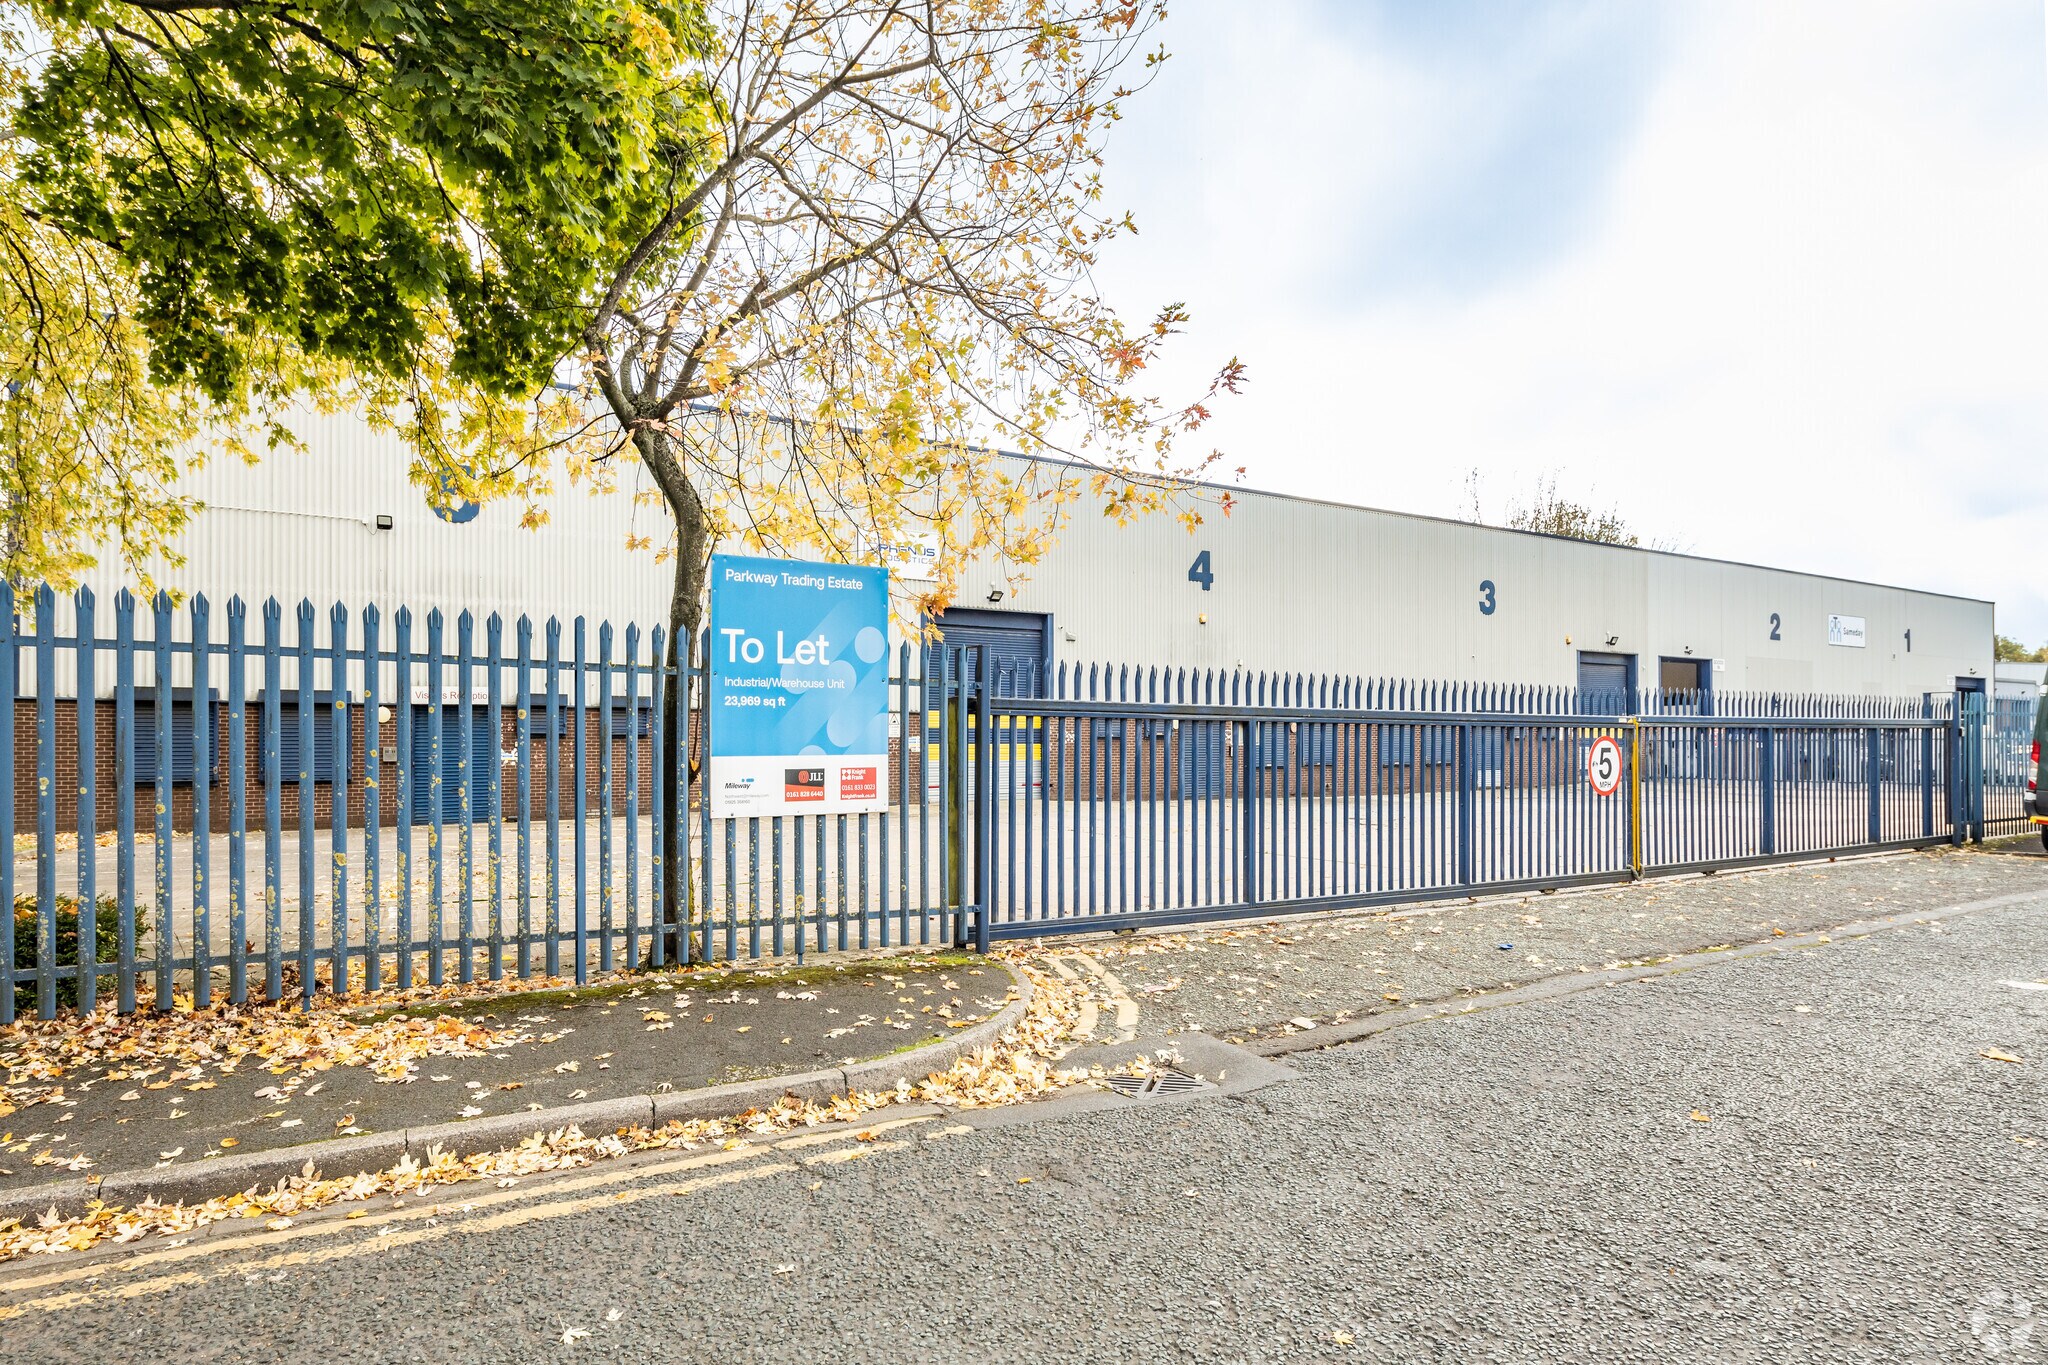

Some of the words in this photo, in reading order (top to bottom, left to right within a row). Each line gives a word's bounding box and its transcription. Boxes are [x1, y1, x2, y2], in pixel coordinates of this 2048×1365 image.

[725, 568, 778, 587] Parkway
[781, 572, 825, 591] Trading
[828, 576, 863, 590] Estate
[1188, 550, 1214, 591] 4
[1479, 580, 1496, 615] 3
[1770, 612, 1781, 641] 2
[1843, 627, 1863, 639] Sameday
[720, 628, 764, 664] To
[777, 630, 830, 666] Let
[1904, 628, 1911, 652] 1
[724, 676, 825, 690] Industrial/Warehouse
[827, 679, 845, 689] Unit
[415, 690, 447, 700] Viss
[450, 691, 490, 701] Rptio
[724, 696, 761, 707] 23,969
[763, 697, 776, 708] sq
[778, 696, 786, 706] ft
[1599, 747, 1612, 780] 5
[724, 782, 751, 790] Mileway
[808, 772, 823, 781] JLL
